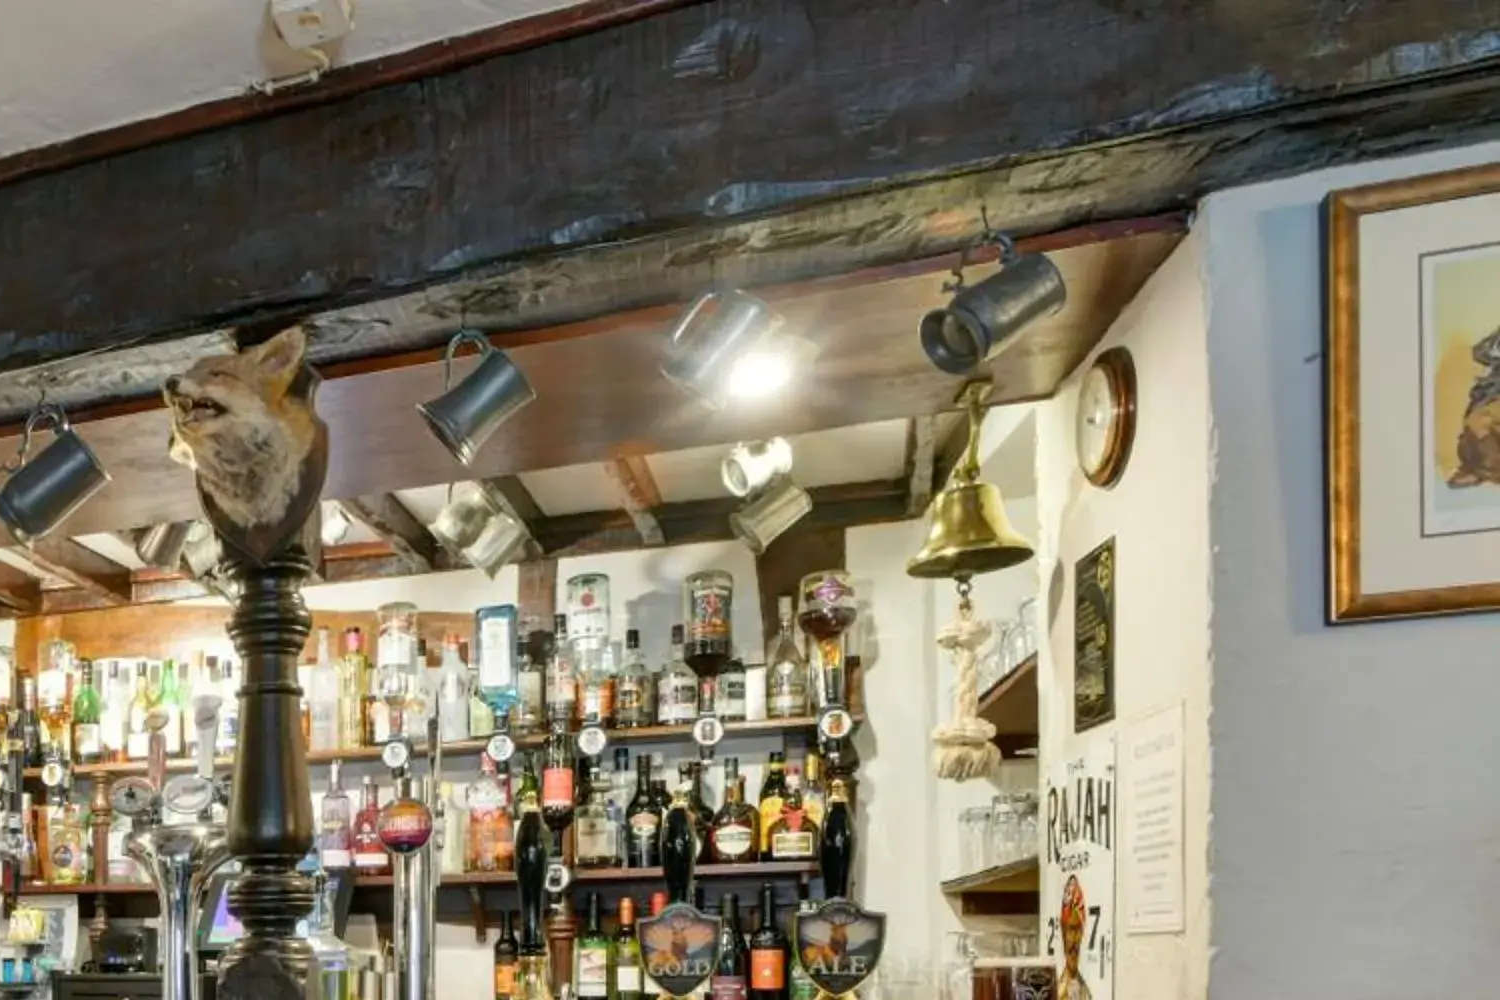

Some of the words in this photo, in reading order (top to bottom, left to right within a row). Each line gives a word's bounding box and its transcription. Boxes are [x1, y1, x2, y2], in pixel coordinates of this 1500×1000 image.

[1046, 776, 1112, 865] RAJAH
[651, 959, 711, 977] GOLD
[809, 955, 868, 977] ALE
